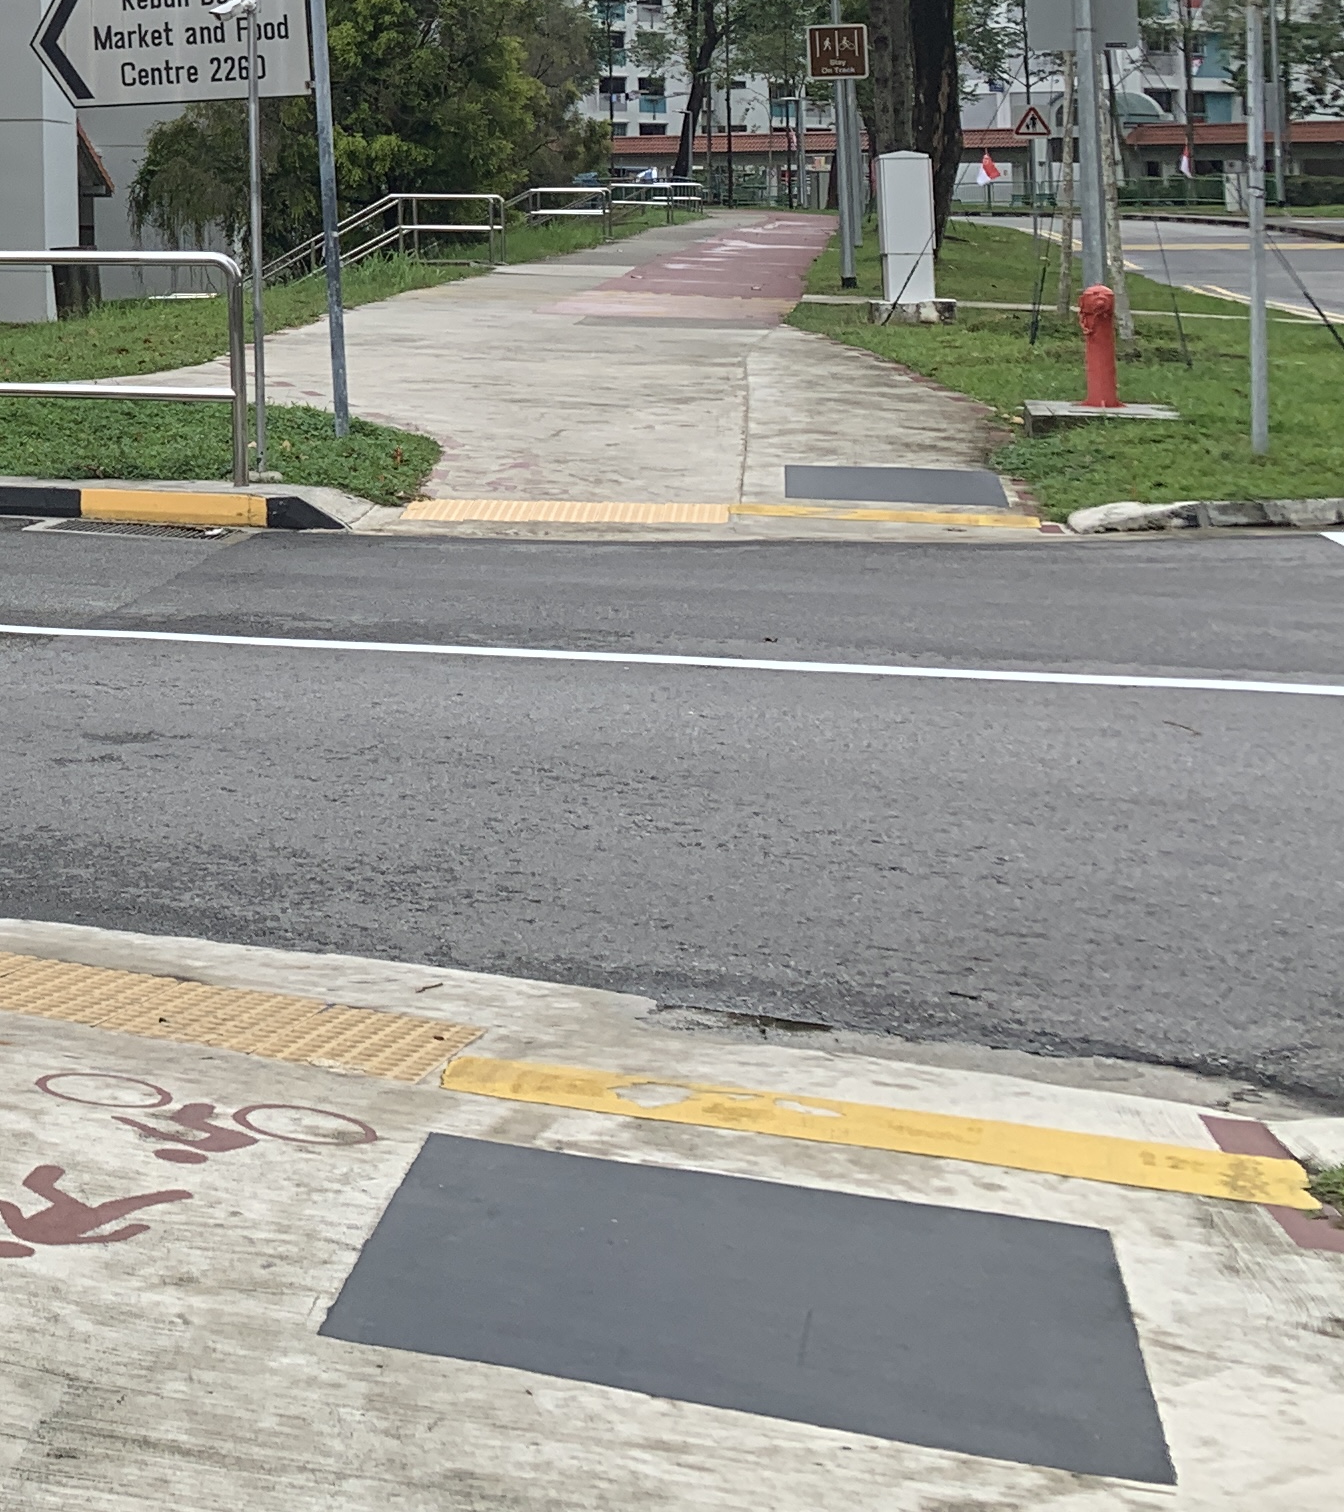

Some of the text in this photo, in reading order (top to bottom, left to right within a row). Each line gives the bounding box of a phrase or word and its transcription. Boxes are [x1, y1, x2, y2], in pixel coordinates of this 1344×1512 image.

[93, 21, 173, 50] Market
[185, 22, 226, 45] and
[121, 59, 199, 87] Centre
